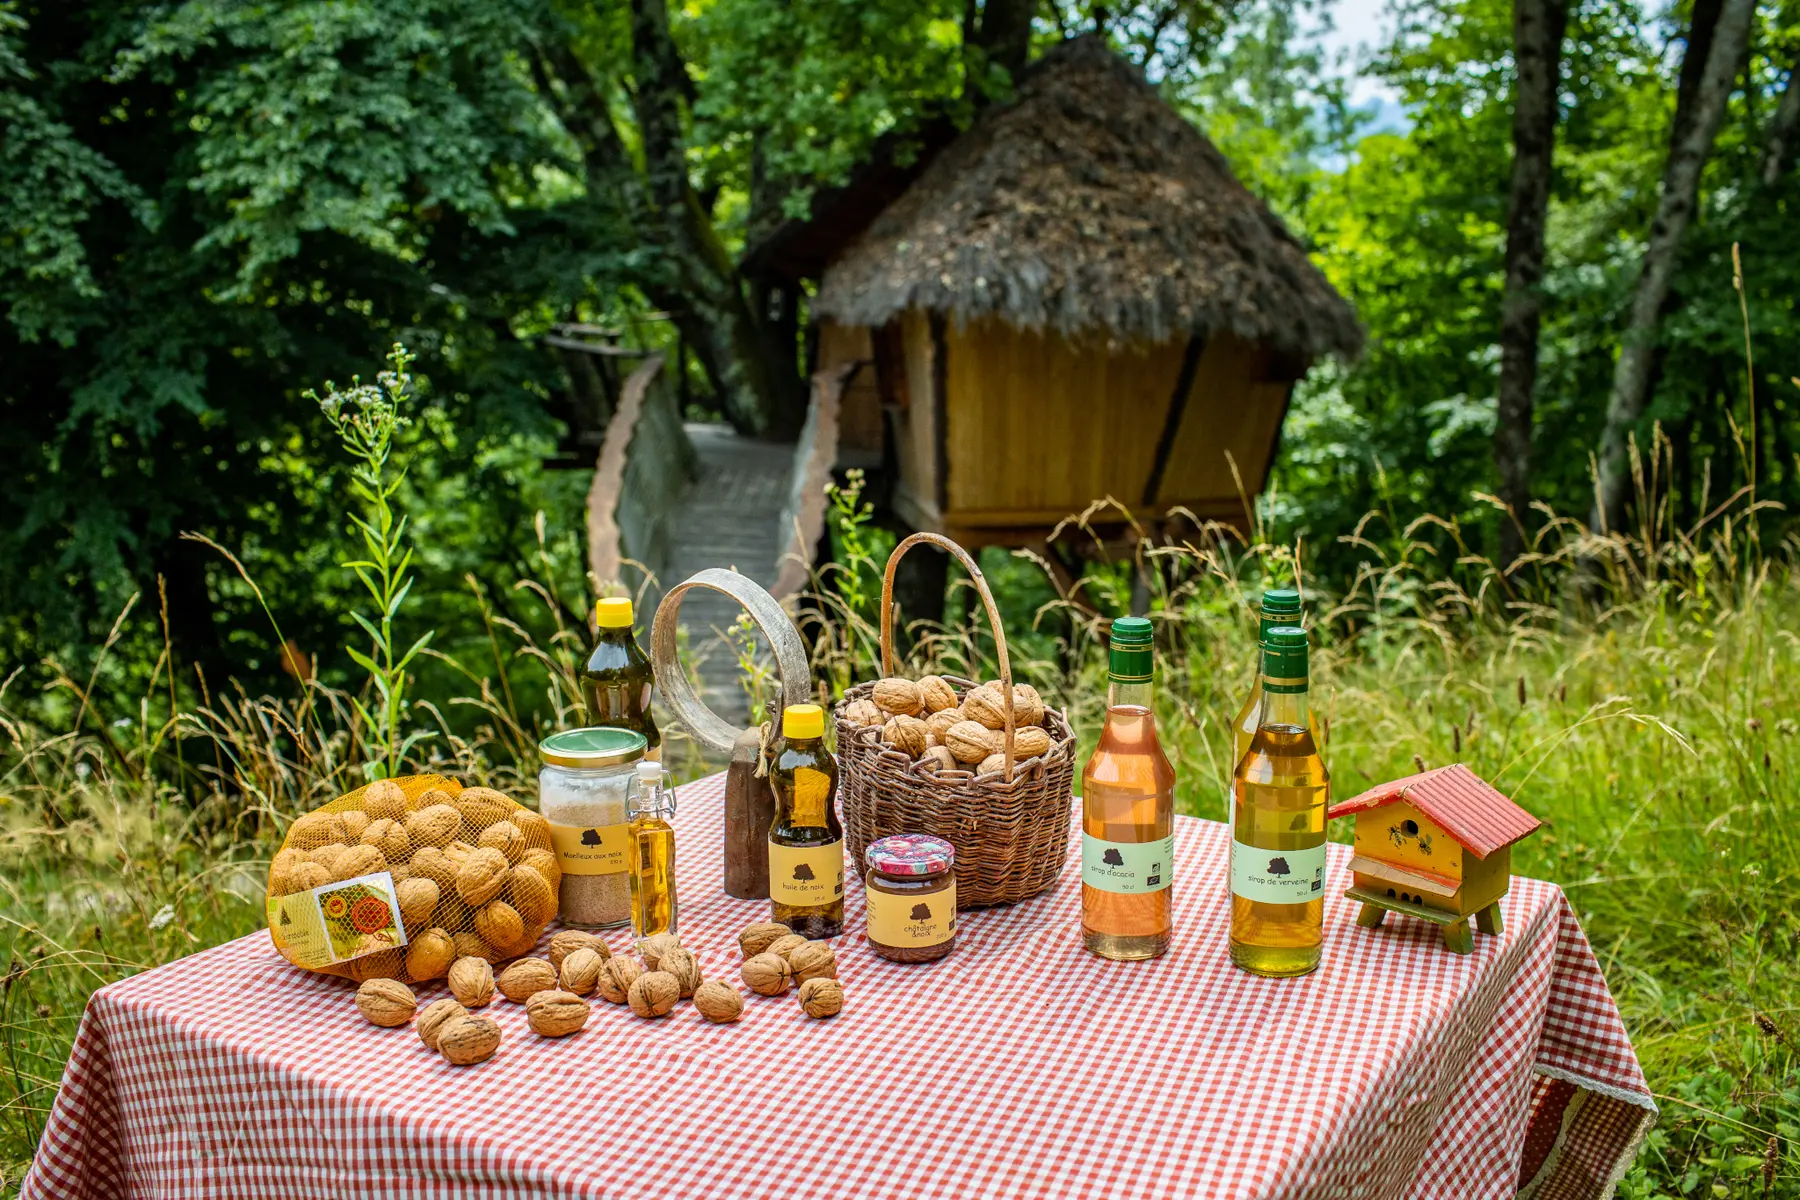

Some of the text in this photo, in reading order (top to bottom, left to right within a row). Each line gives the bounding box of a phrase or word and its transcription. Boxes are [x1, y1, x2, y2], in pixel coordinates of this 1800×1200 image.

[563, 851, 592, 860] Moelleux
[608, 851, 623, 859] noix
[1091, 865, 1135, 878] sirop d'acacia
[1248, 875, 1309, 886] sirop de verveine
[782, 882, 798, 891] huile
[810, 883, 824, 891] noix
